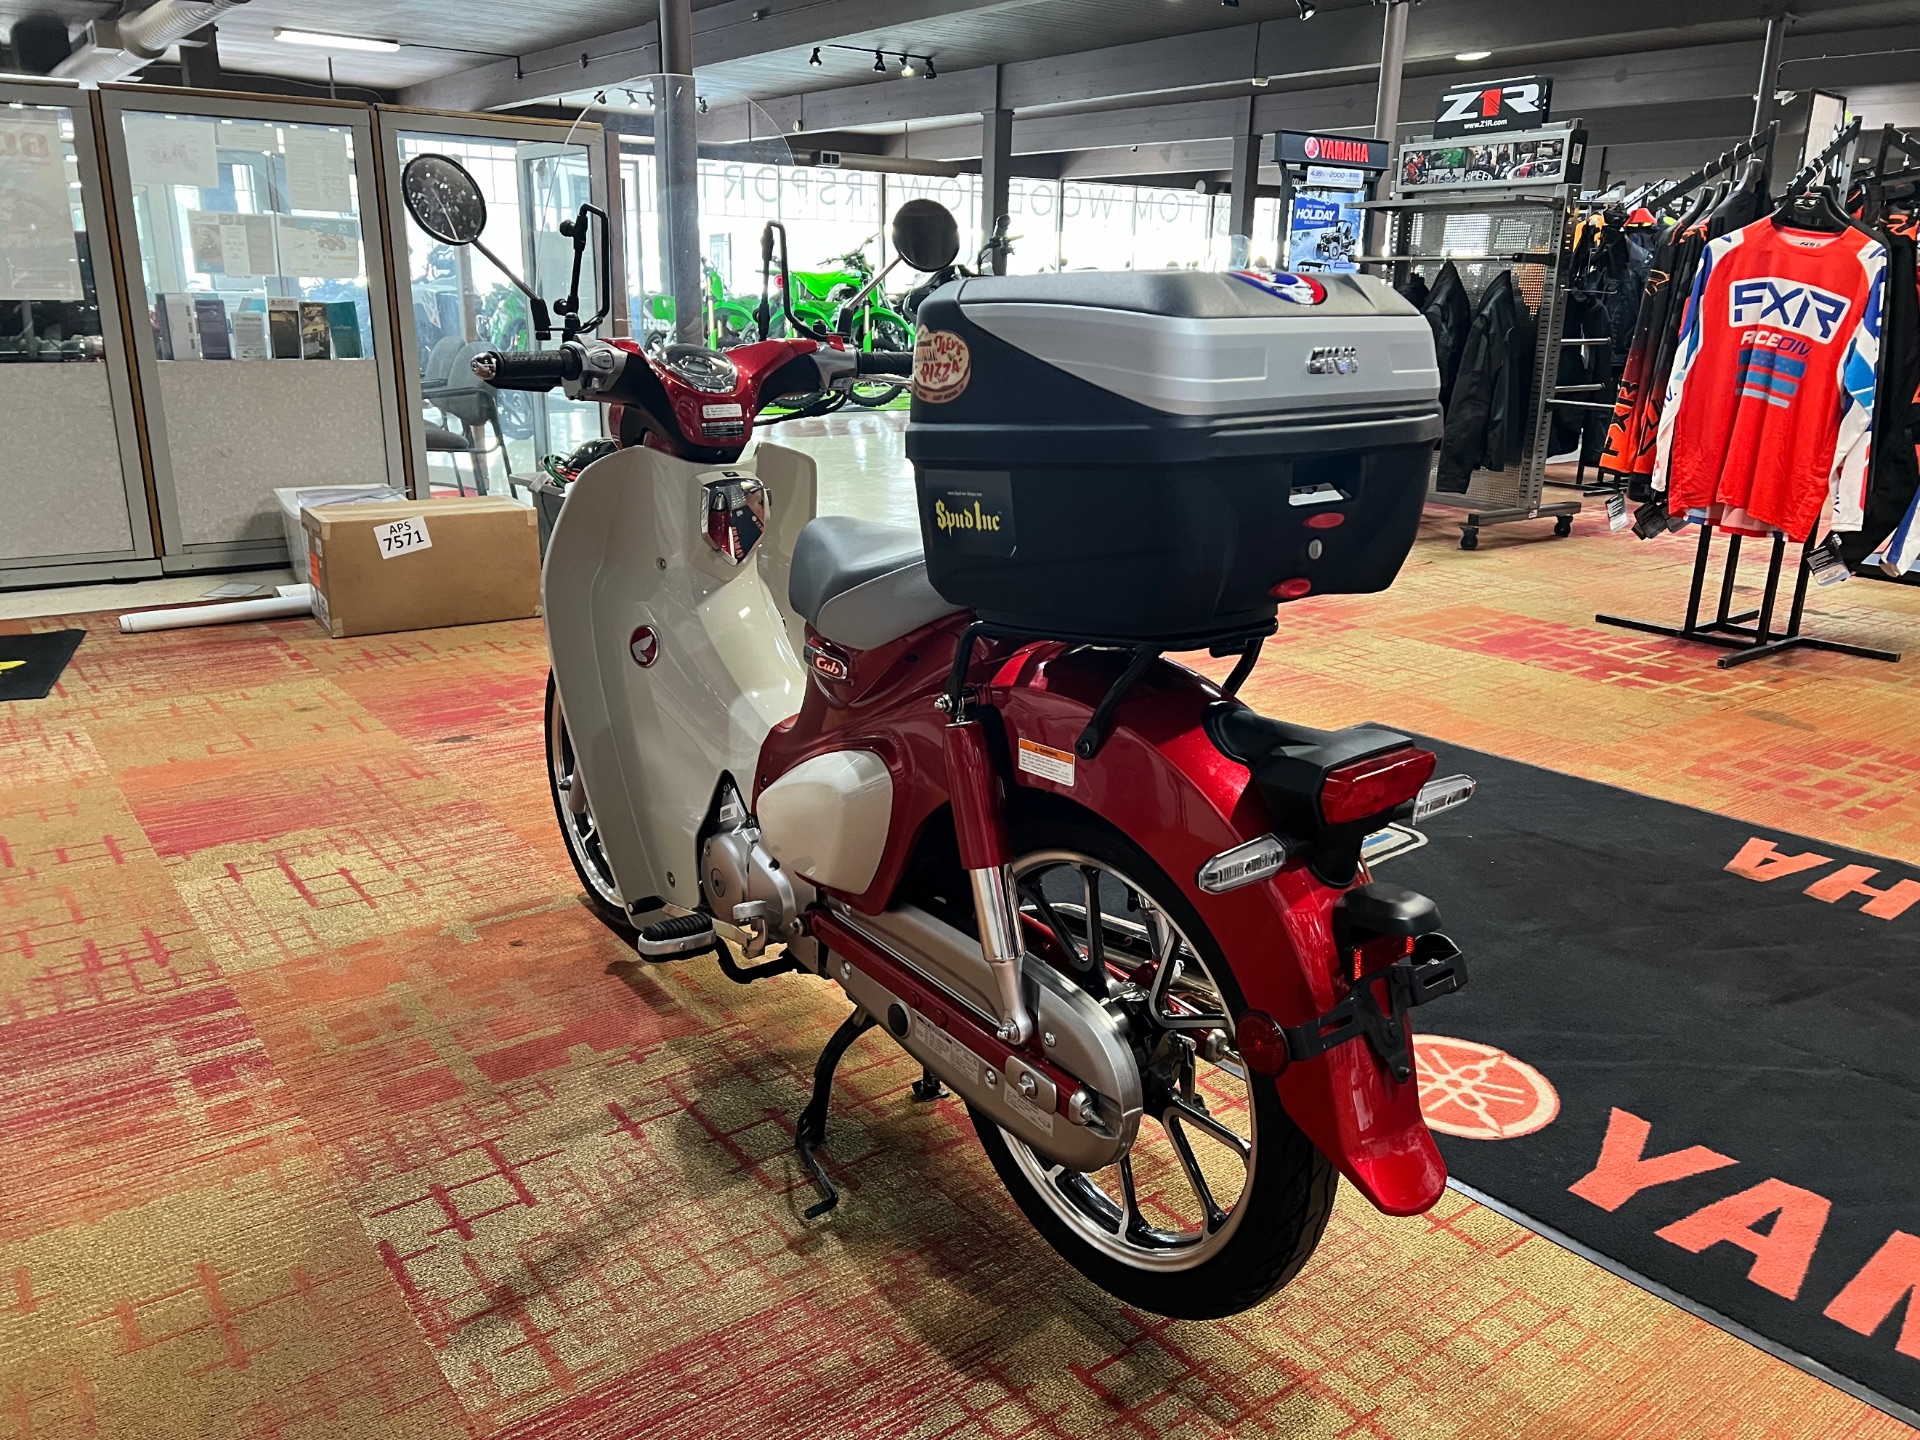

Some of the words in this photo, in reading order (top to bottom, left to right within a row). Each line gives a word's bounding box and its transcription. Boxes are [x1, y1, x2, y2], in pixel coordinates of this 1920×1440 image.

[1437, 83, 1539, 122] Z1R
[1463, 118, 1508, 130] www.Z1R.com
[1319, 138, 1369, 163] YAMAHA
[1296, 208, 1336, 221] HOLIDAY
[1734, 281, 1846, 339] FXR
[922, 359, 960, 383] PIZZA
[1603, 379, 1640, 458] FXR
[389, 521, 411, 535] APS
[935, 498, 974, 537] Spud
[974, 499, 1001, 532] Inc
[383, 530, 425, 552] 7571
[816, 656, 840, 675] Cub
